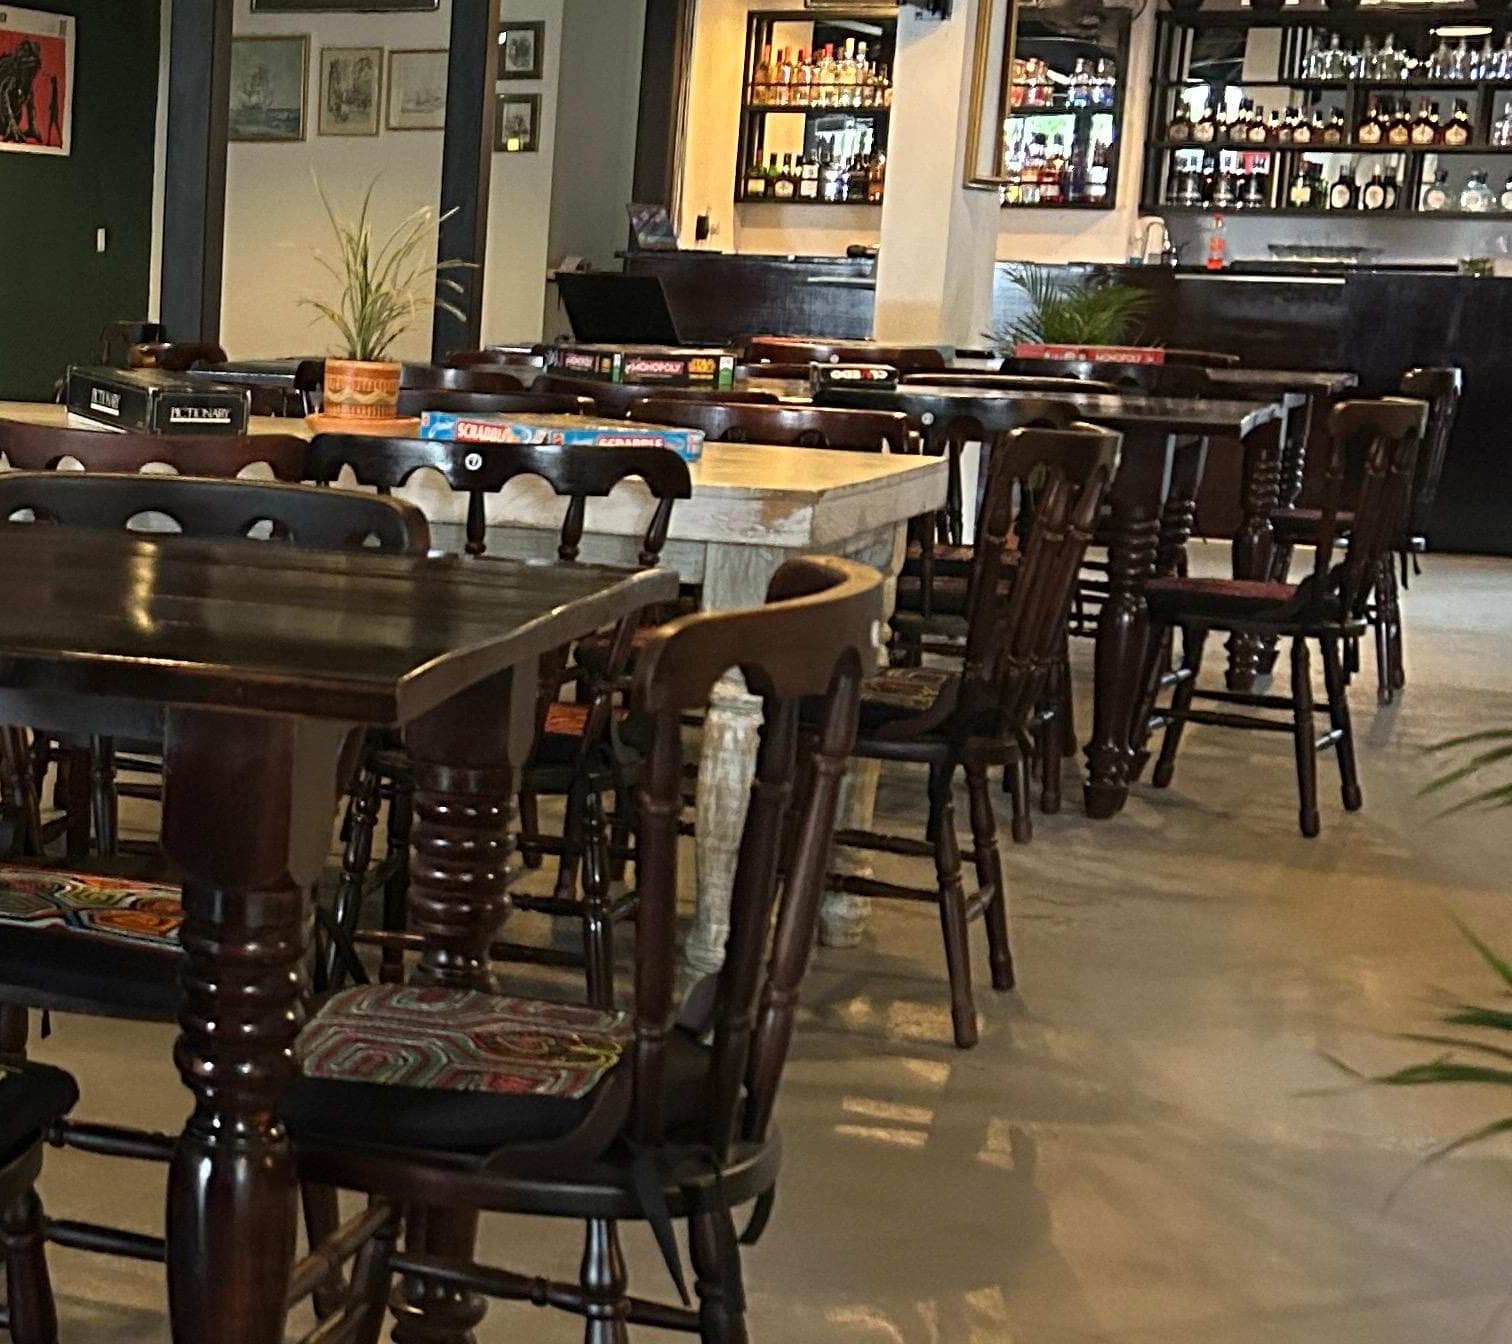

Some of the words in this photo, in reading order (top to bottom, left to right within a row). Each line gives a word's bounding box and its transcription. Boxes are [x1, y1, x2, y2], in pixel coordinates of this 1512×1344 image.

[625, 360, 685, 375] MONOPOLY
[170, 407, 232, 419] PICTIONARY
[457, 422, 518, 443] SCRABBL
